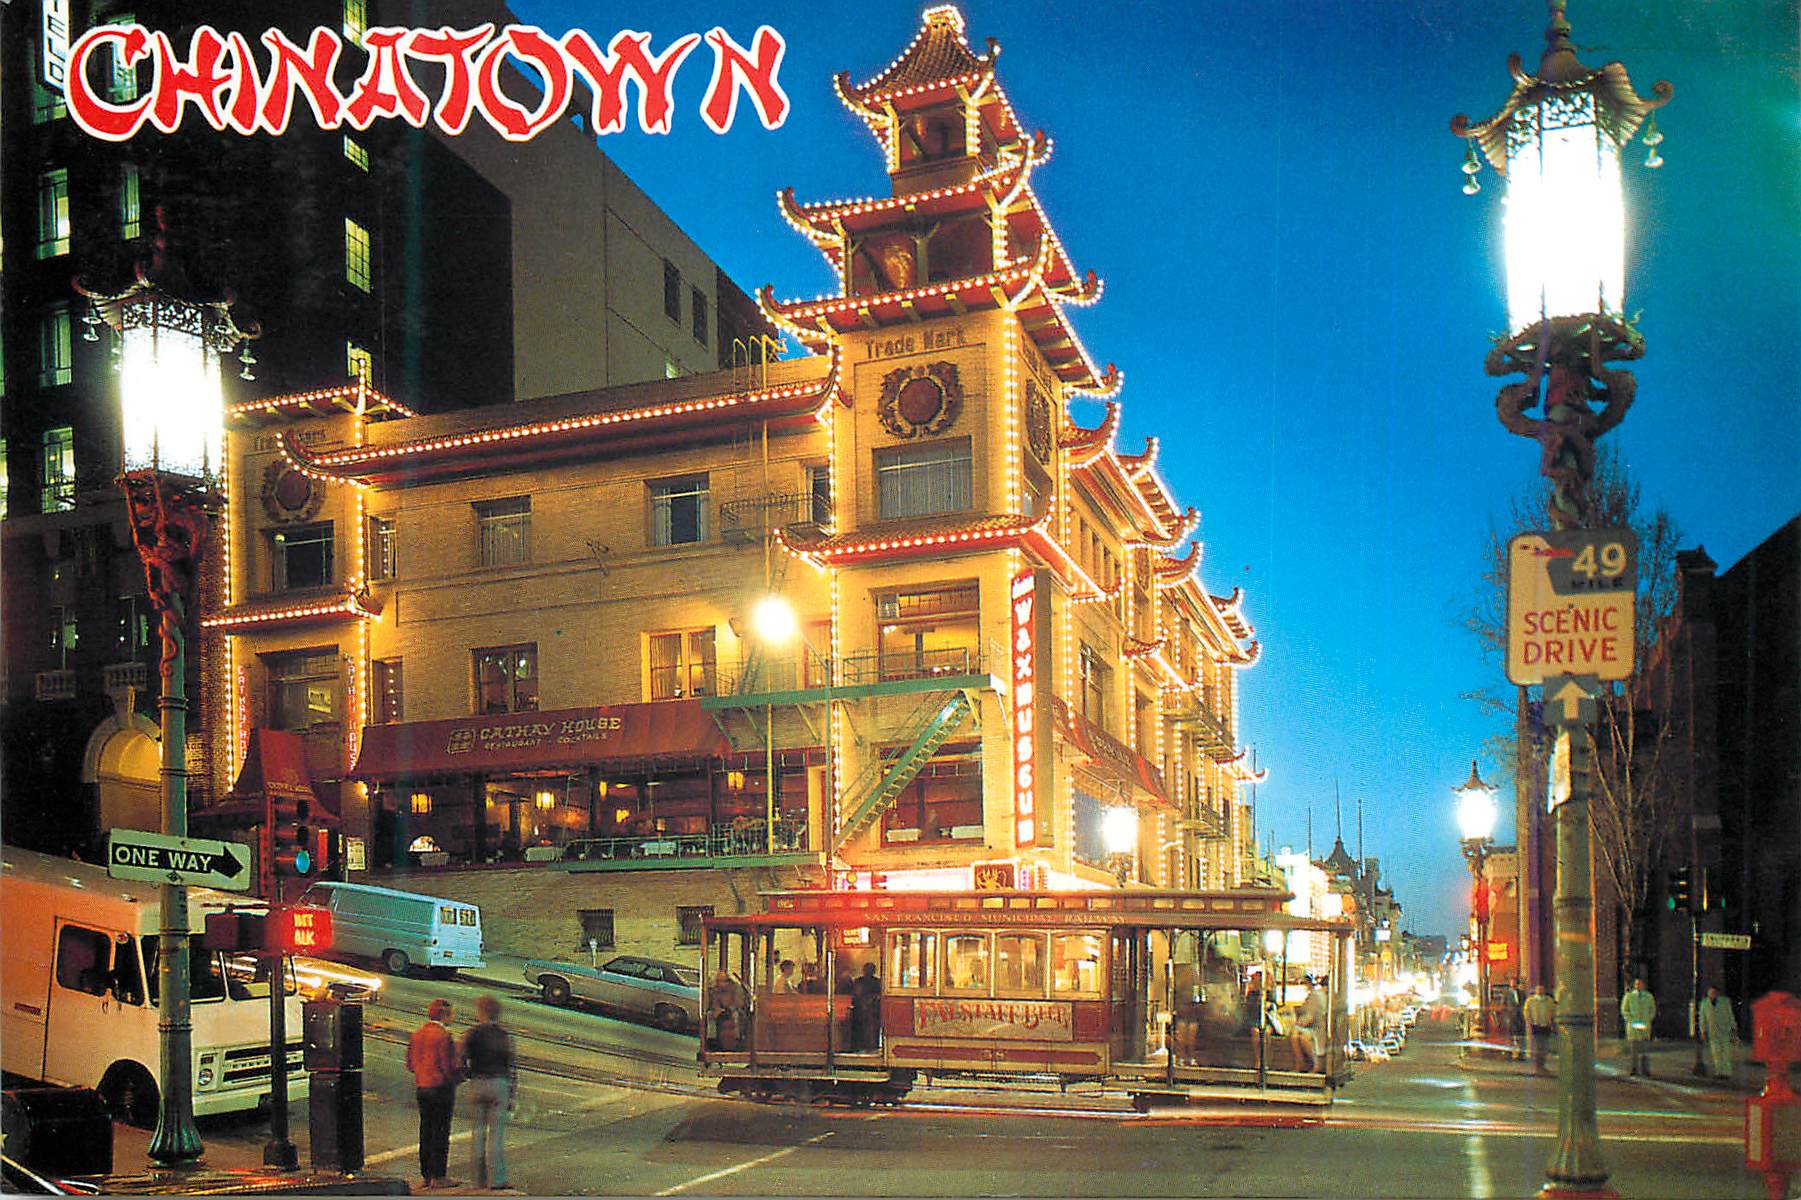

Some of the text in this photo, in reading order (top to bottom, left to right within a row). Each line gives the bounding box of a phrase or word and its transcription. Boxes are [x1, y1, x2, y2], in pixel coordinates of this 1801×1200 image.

[1572, 542, 1626, 578] 49
[1523, 607, 1617, 635] SCENIC
[1523, 637, 1617, 664] DRIVE
[480, 717, 622, 740] CATHAY HOUSE
[1014, 597, 1034, 843] WAX MUSEUM
[115, 846, 211, 871] ONE WAY
[863, 913, 1125, 924] SAN FRANCISCO MUNICIPAL RAILWAY
